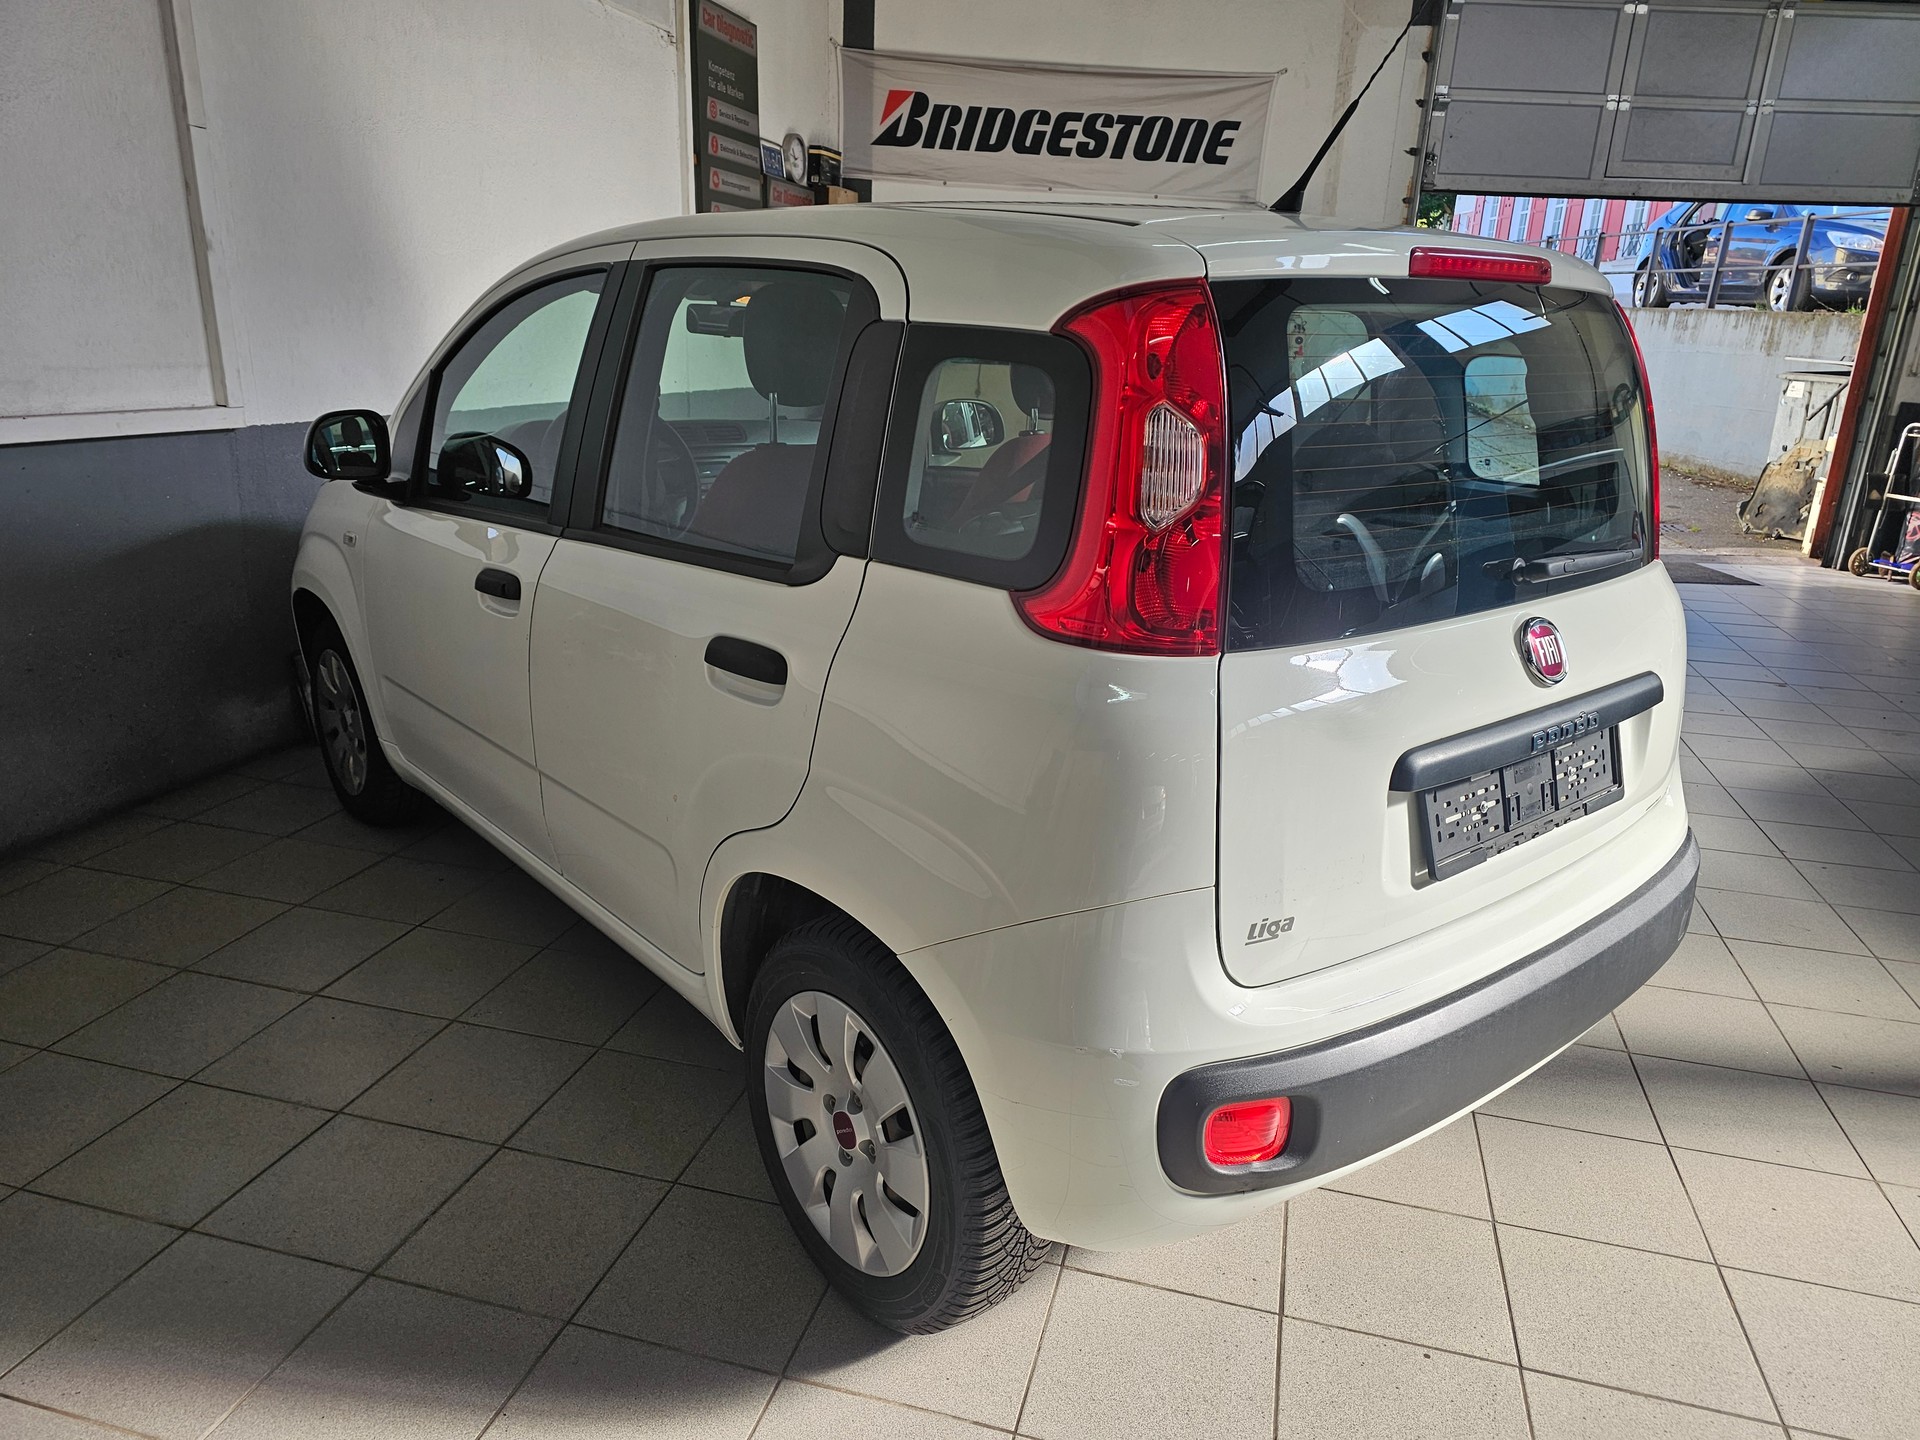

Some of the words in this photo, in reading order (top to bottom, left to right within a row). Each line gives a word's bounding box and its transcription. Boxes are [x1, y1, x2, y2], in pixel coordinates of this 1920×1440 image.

[702, 7, 715, 29] Car
[716, 14, 754, 49] Diagnostic
[871, 89, 1241, 165] BRIDGESTONE
[1534, 634, 1561, 667] FIAT
[1531, 710, 1600, 755] panda
[1245, 916, 1295, 946] Liga
